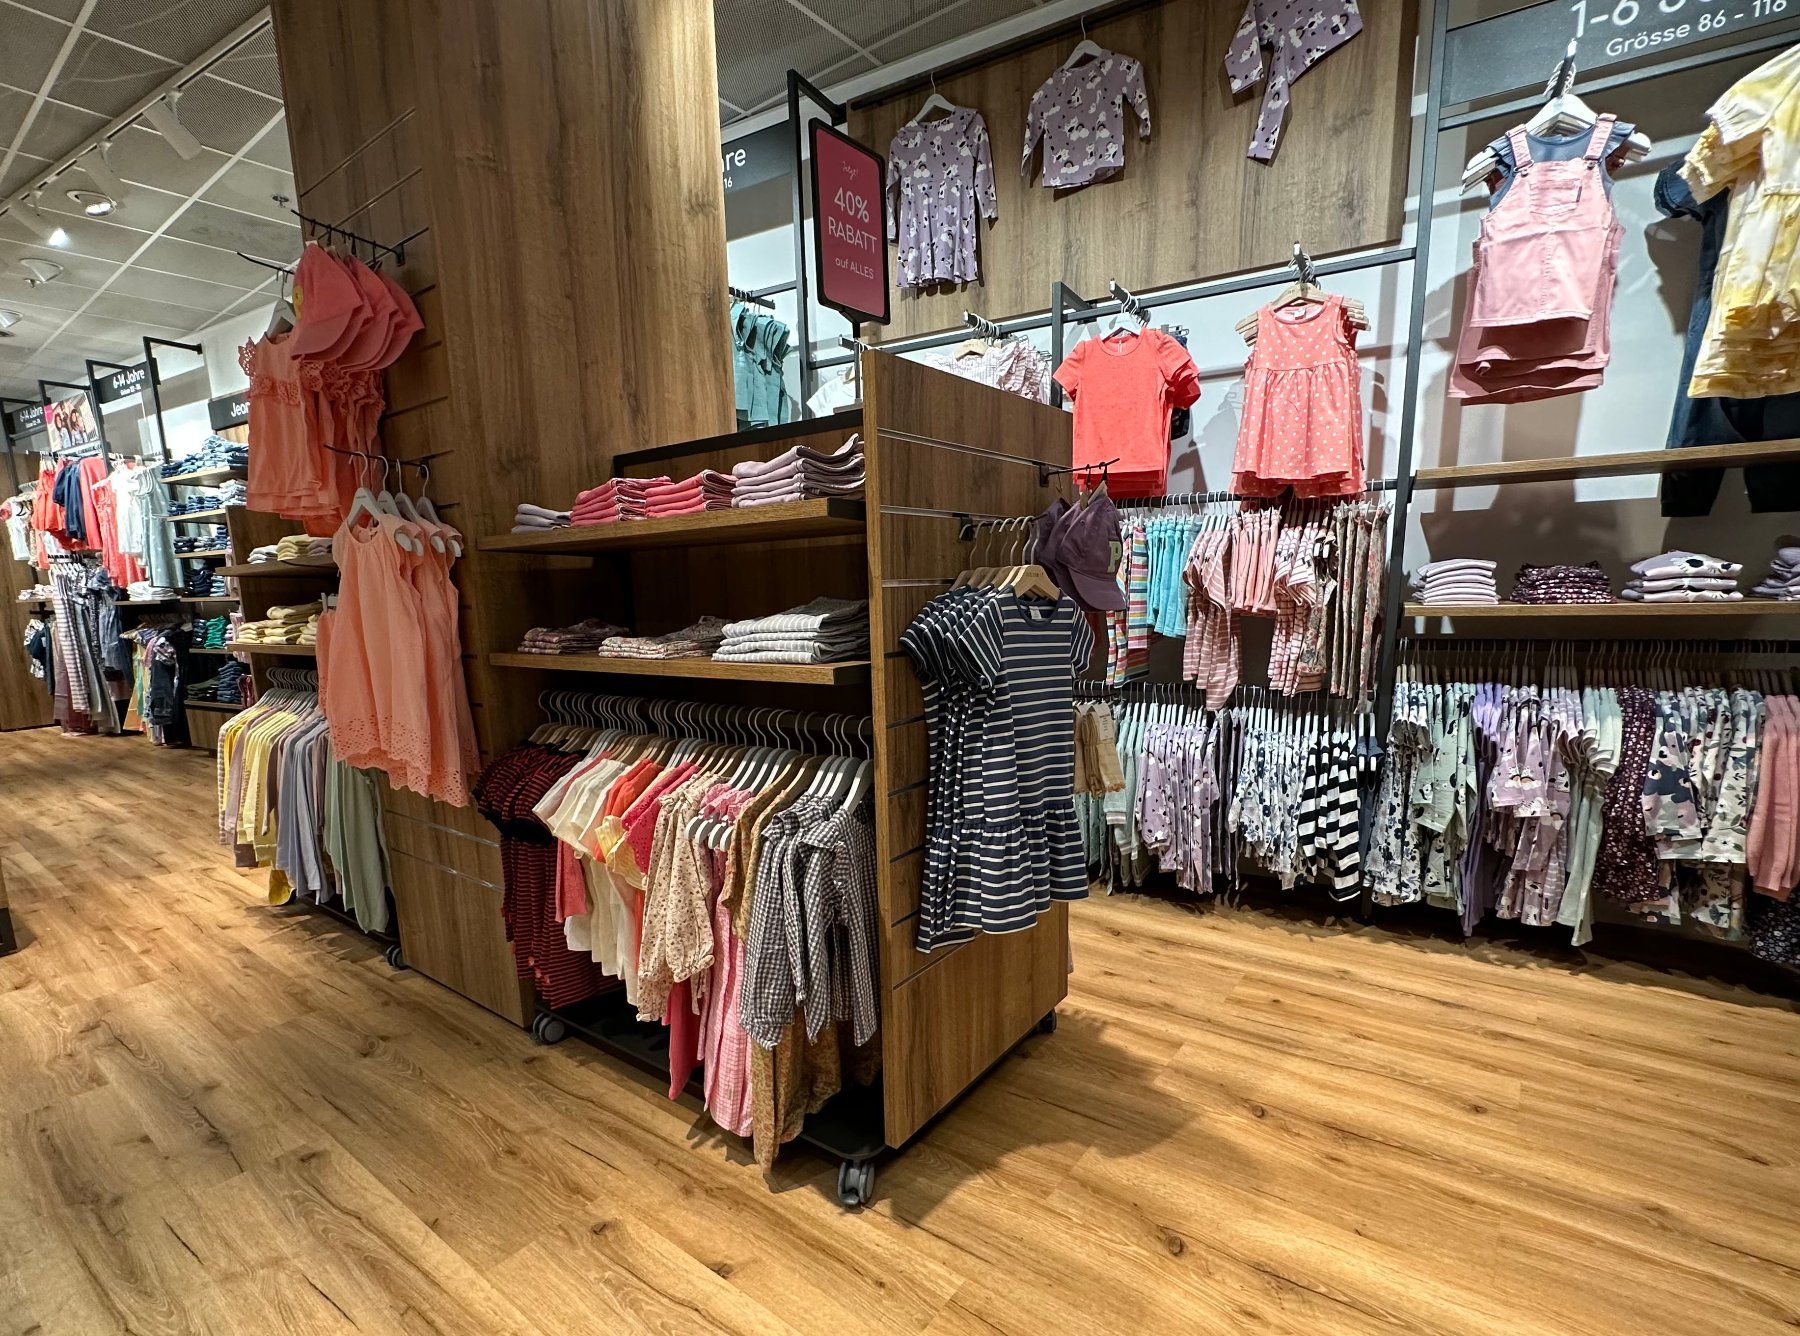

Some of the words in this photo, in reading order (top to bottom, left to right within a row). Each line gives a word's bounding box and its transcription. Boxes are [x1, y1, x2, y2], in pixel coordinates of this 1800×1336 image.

[1570, 0, 1640, 38] 1-6
[1606, 24, 1691, 56] Grösse
[1697, 9, 1727, 32] 86
[1752, 0, 1787, 18] 116
[834, 187, 870, 223] 40%
[828, 216, 878, 254] RABATT
[835, 257, 849, 270] auf
[850, 260, 875, 280] ALLES
